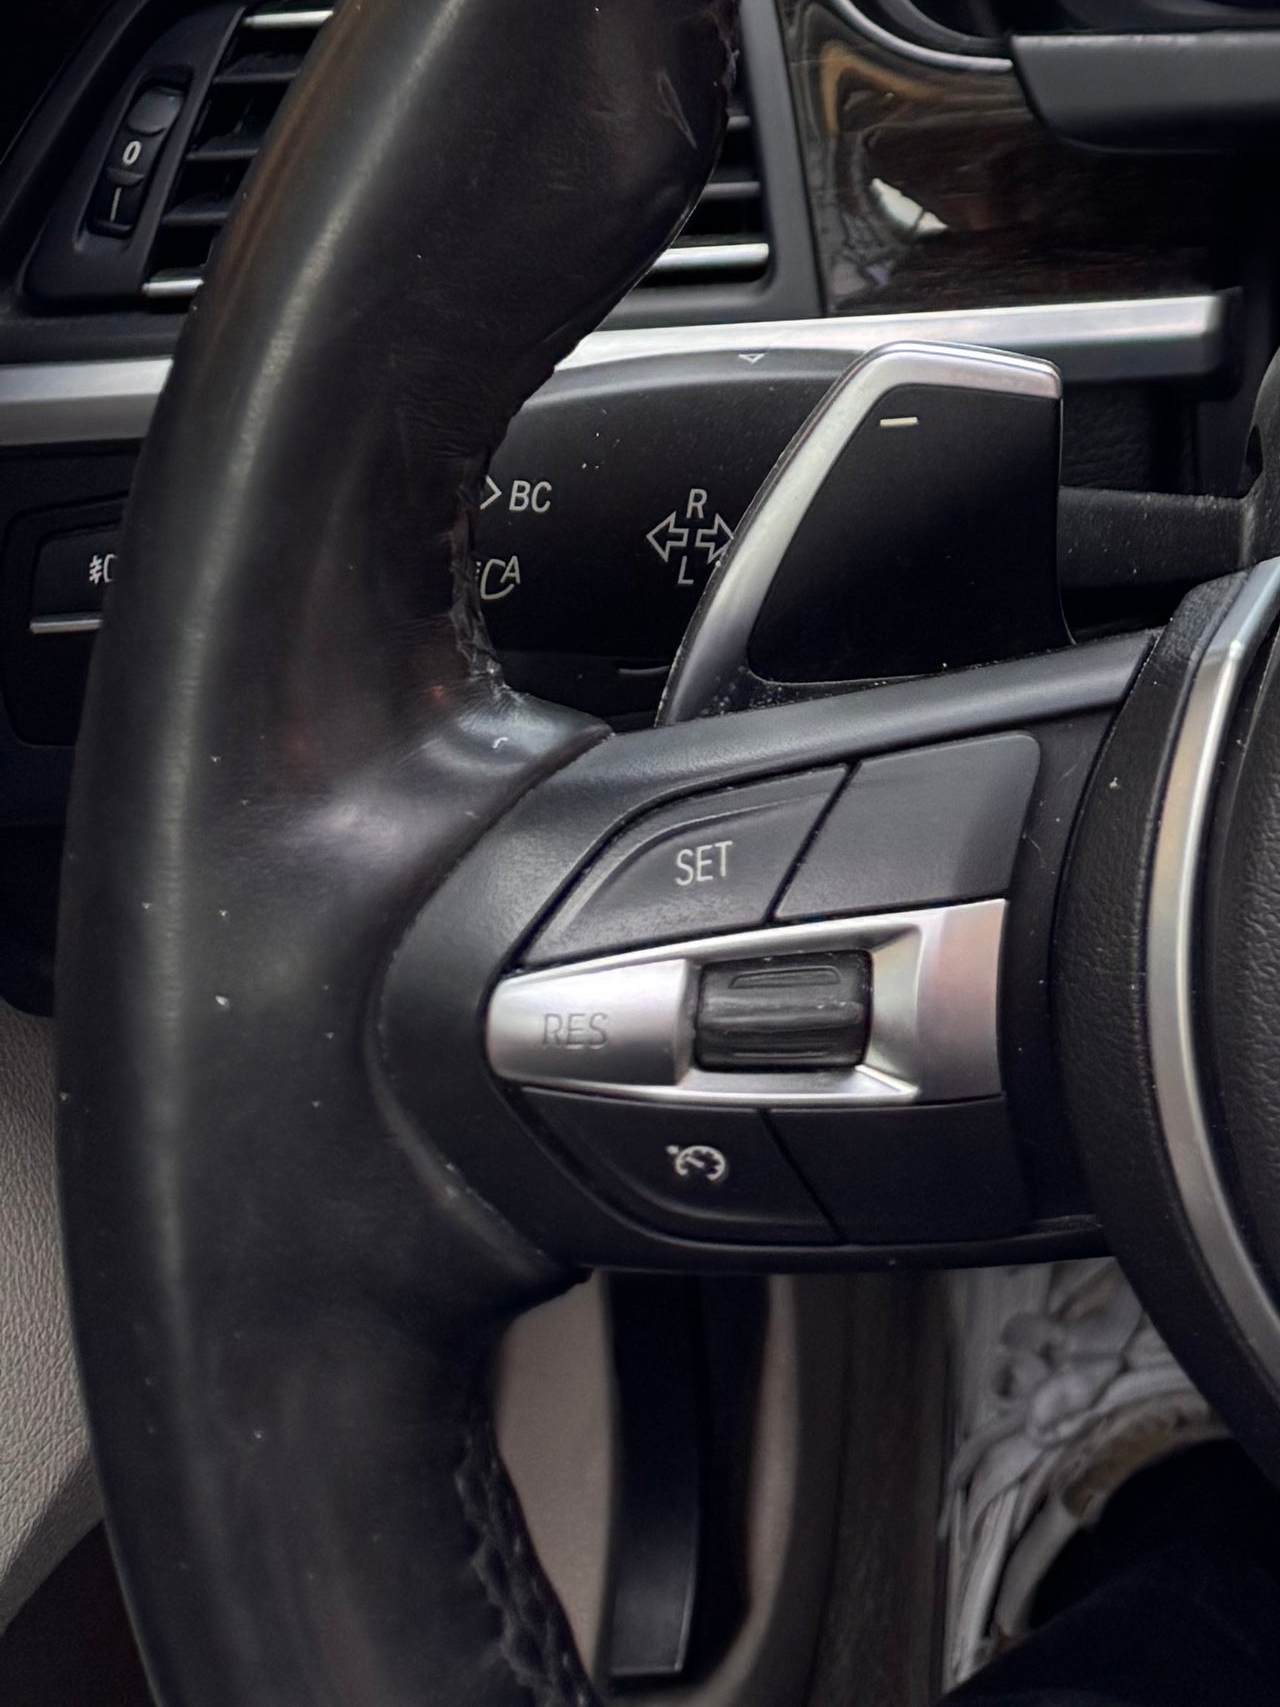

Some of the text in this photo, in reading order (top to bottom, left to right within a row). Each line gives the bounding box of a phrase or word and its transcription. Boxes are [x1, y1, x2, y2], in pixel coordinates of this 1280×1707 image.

[508, 480, 553, 513] BC
[685, 488, 708, 519] R
[677, 555, 695, 585] L
[675, 840, 734, 886] SET
[542, 1011, 609, 1051] RES
